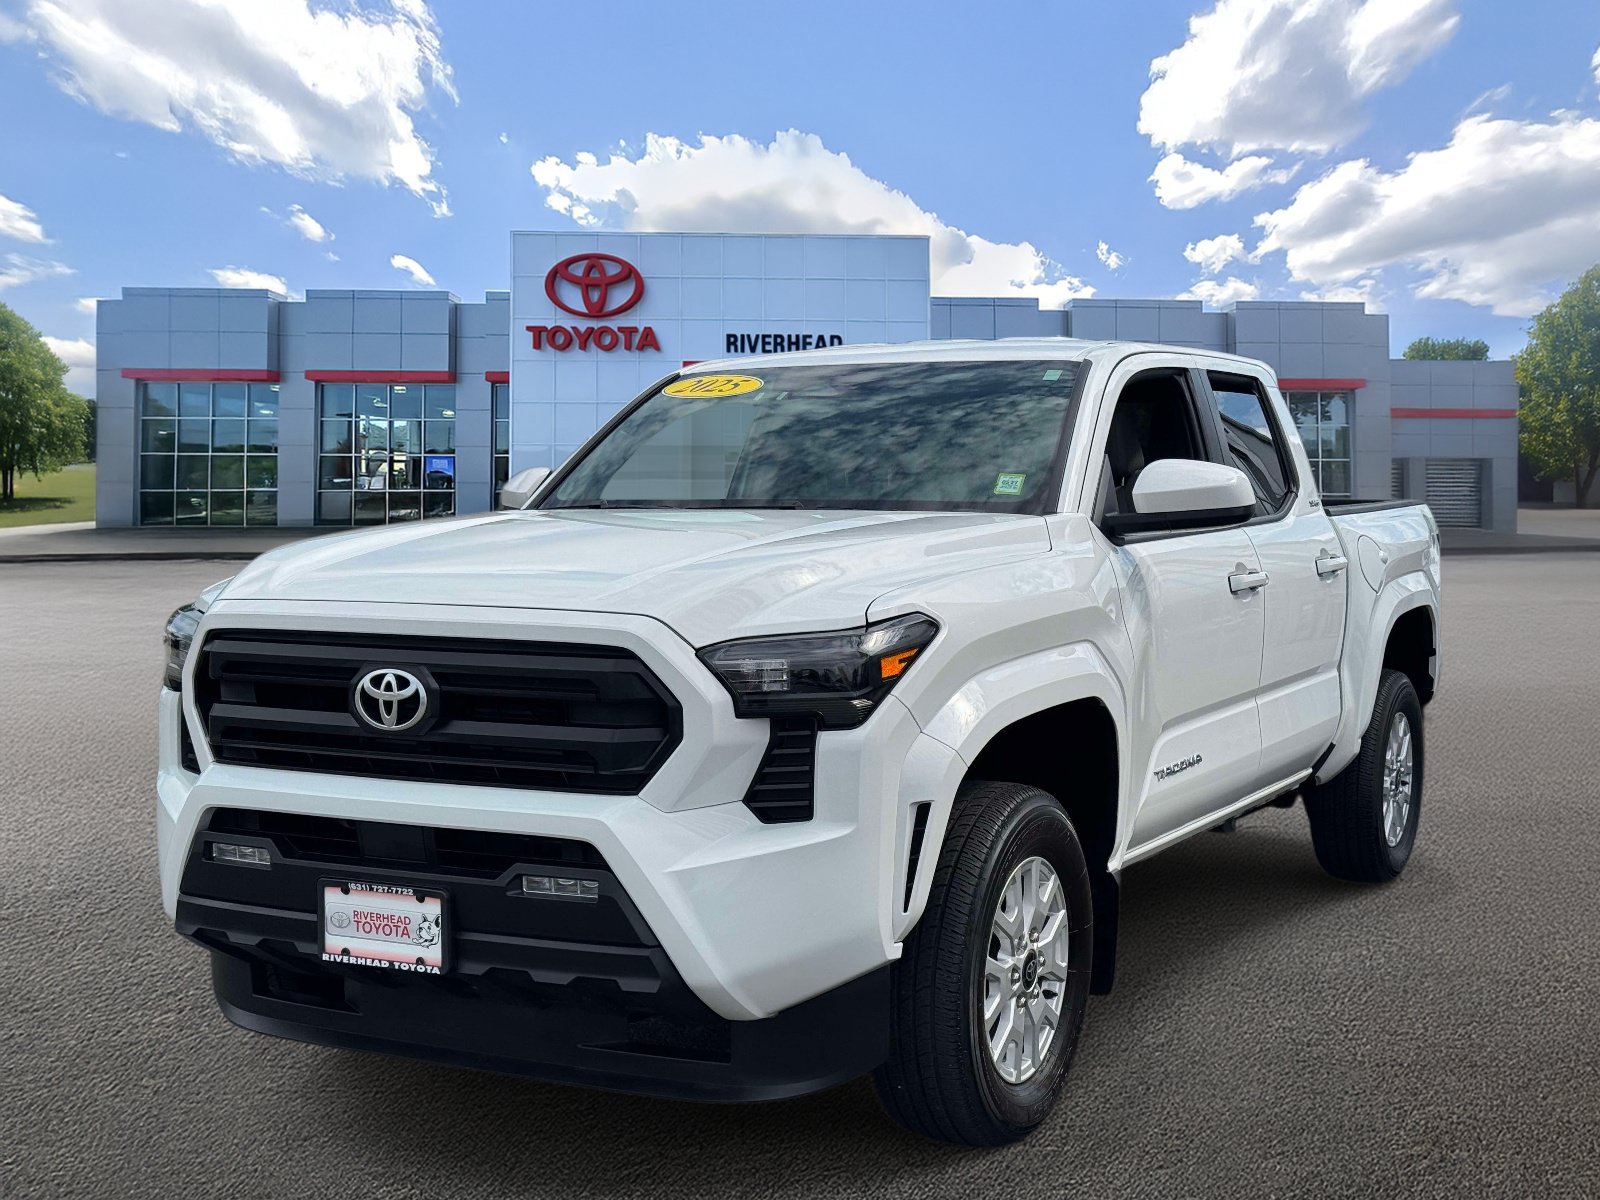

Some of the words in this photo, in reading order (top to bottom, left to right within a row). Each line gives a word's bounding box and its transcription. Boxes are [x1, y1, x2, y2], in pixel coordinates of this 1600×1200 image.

[526, 325, 660, 351] TOYOTA
[672, 379, 751, 393] 2025
[1153, 754, 1202, 781] TACOMA
[348, 882, 369, 891] (631)
[371, 885, 414, 895] 727-7722
[353, 910, 411, 925] RIVERHEAD
[353, 920, 410, 938] TOYOTA
[322, 953, 389, 967] RIVERHEAD
[393, 961, 440, 974] TOYOTA
